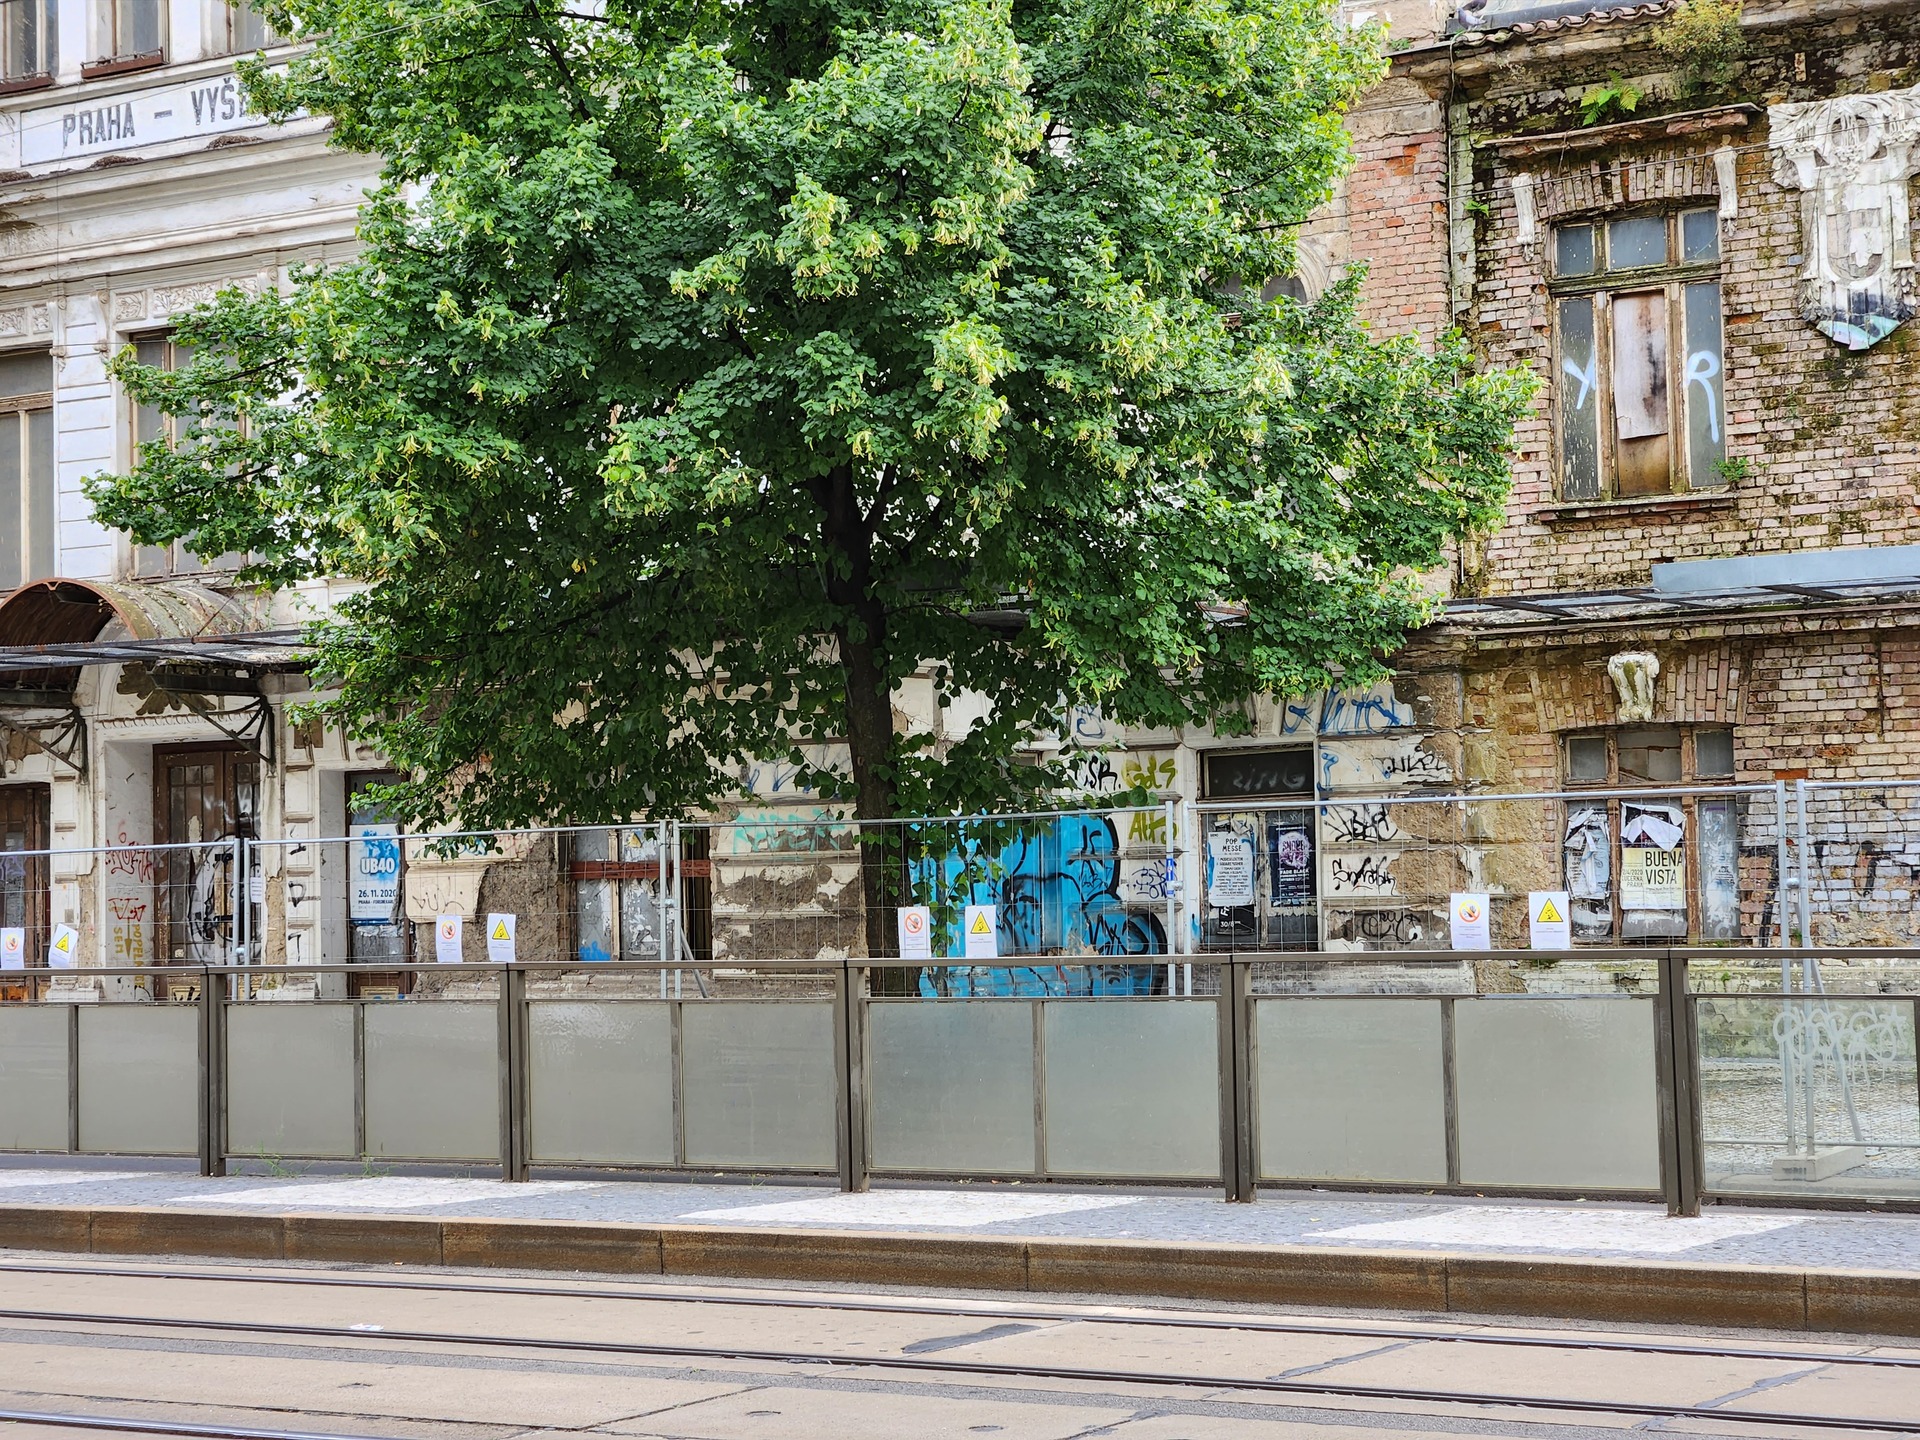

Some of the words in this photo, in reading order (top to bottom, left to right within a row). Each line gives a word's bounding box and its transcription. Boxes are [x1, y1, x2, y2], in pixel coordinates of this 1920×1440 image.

[62, 101, 136, 147] PRAHA
[1222, 844, 1242, 852] MESSE
[360, 857, 396, 874] UB40
[1645, 851, 1682, 867] BUENA
[1645, 869, 1677, 885] VISTA
[358, 889, 370, 898] 26.
[371, 889, 379, 898] 11.
